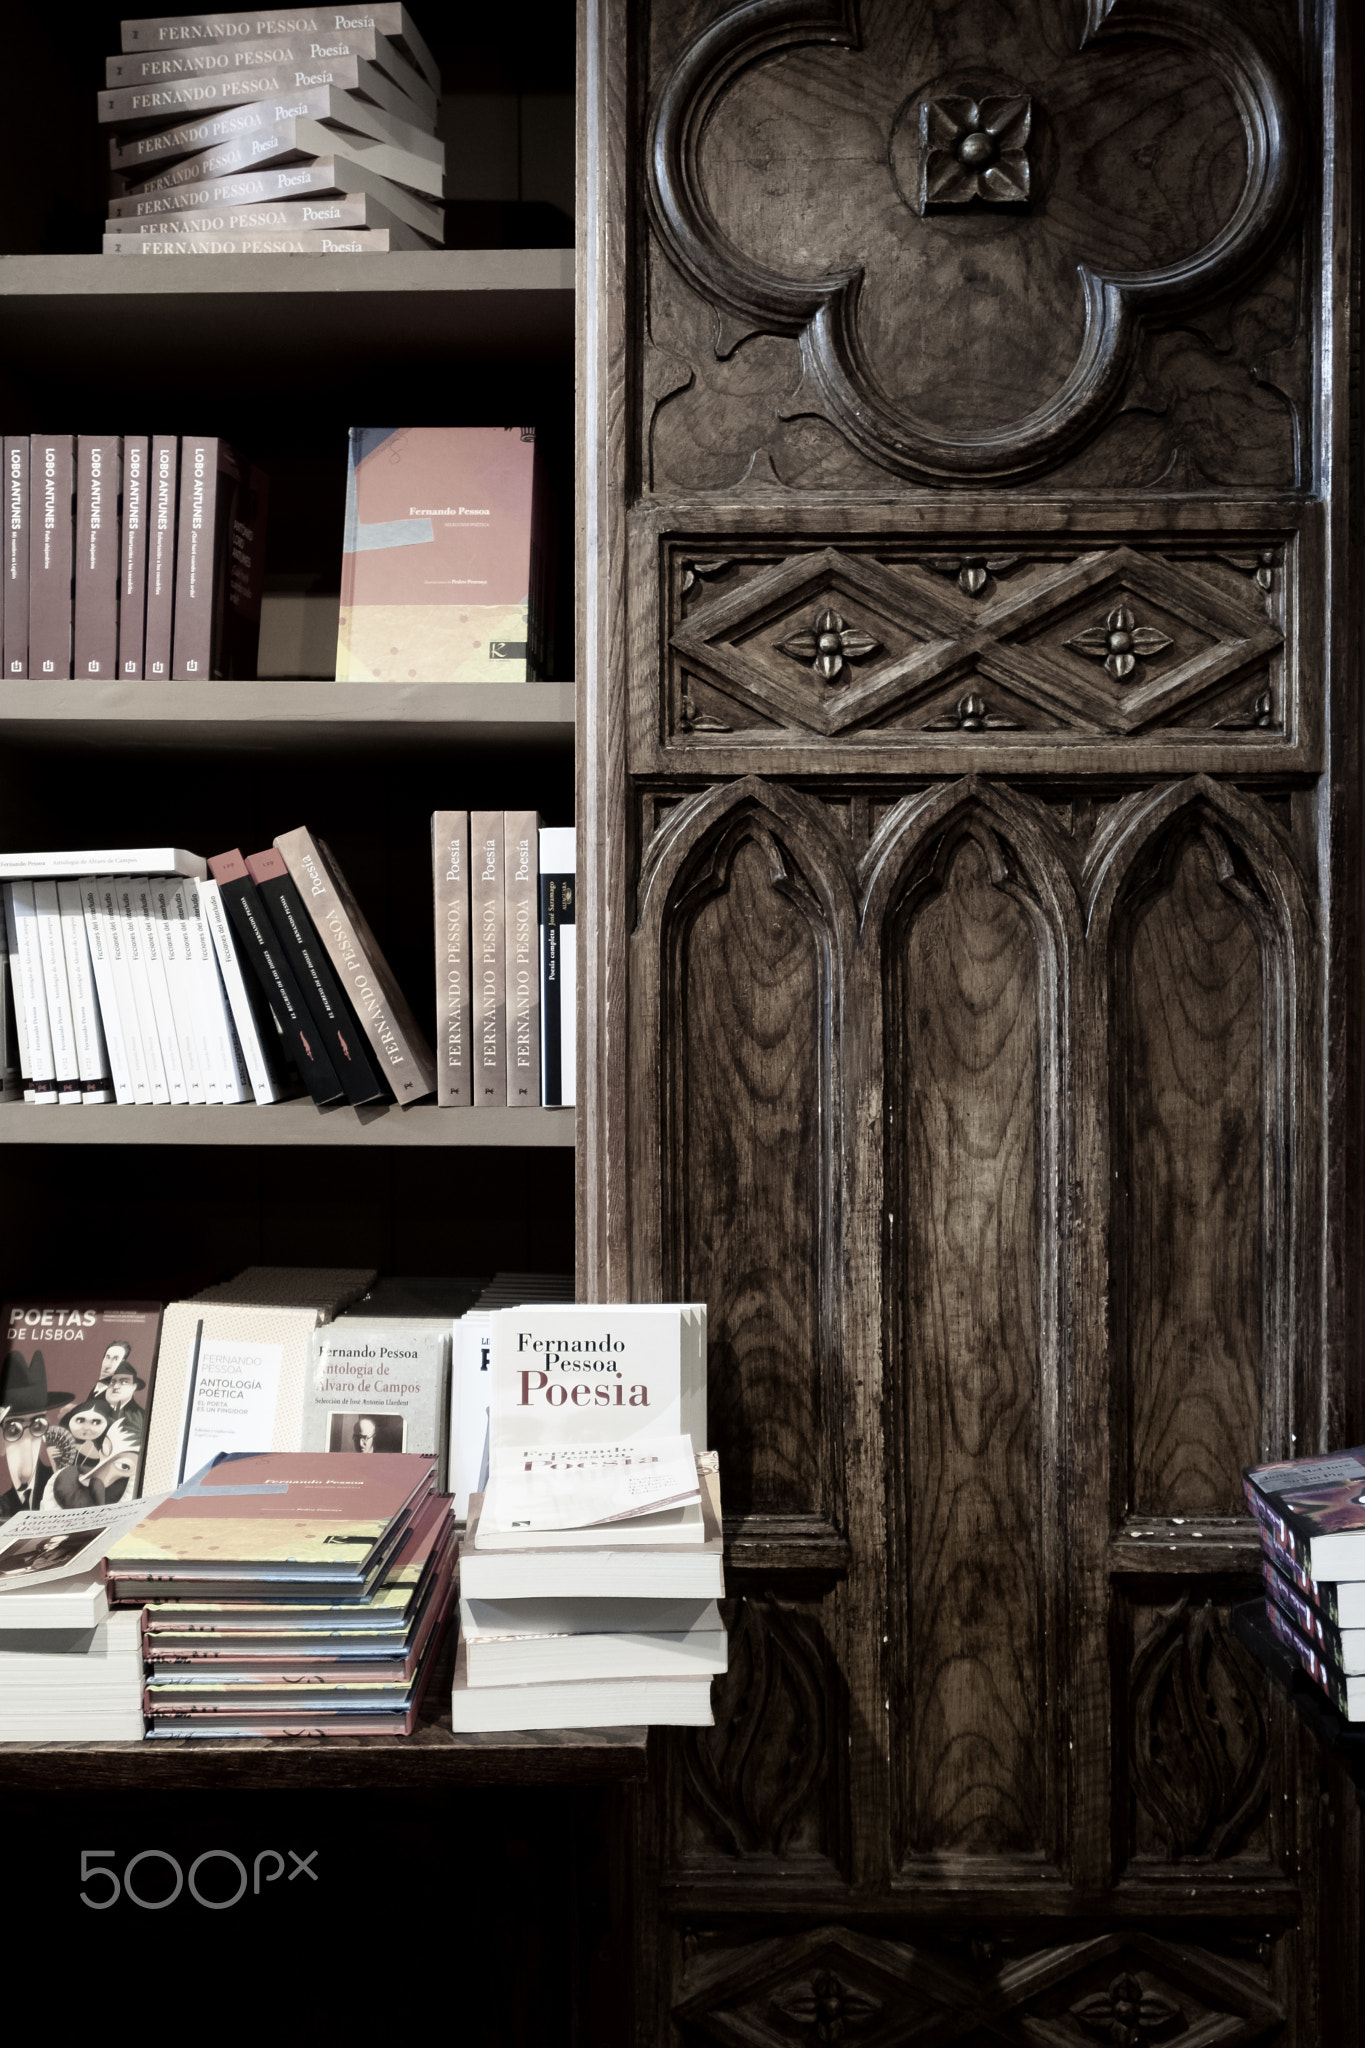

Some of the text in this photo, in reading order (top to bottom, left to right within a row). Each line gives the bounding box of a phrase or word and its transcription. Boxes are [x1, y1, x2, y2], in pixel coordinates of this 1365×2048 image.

[159, 15, 375, 41] FERNANDO PESSOA Poesía
[142, 42, 350, 76] FERNANDO PESSOA Poesía
[132, 71, 333, 108] FERNANDO PESSOA Poesía
[137, 103, 308, 154] FERNANDO PESSOA Poesía
[144, 135, 278, 194] FERNANDO PESSOA Poesía
[136, 173, 311, 216] FERNANDO PESSOA Poesía
[140, 206, 340, 234] FERNANDO PESSOA Poesía
[142, 239, 362, 254] FERNANDO PESSOA Poesía
[11, 450, 21, 530] LOBO ANTUNES
[45, 448, 54, 529] LOBO ANTUNES
[91, 448, 101, 529] LOBO ANTUNES
[129, 449, 140, 529] LOBO ANTUNES
[158, 450, 169, 530] LOBO ANTUNES
[193, 448, 204, 529] LOBO ANTUNES
[410, 507, 490, 516] Fernando Pessoa
[87, 893, 96, 920] interludio
[105, 893, 114, 920] interludio
[122, 893, 131, 920] interludio
[140, 894, 149, 920] interludio
[158, 894, 168, 920] interludio
[175, 894, 184, 920] interludio
[191, 894, 201, 920] interludio
[240, 896, 252, 916] PESSOA
[279, 895, 291, 914] PESSOA
[548, 881, 556, 911] Saramago
[209, 896, 232, 962] Ficciones del interludio
[248, 917, 265, 945] FERNANDO
[287, 914, 303, 943] FERNANDO
[95, 932, 104, 960] Ficciones
[112, 932, 122, 960] Ficciones
[130, 932, 139, 960] Ficciones
[148, 932, 157, 960] Ficciones
[166, 932, 176, 960] Ficciones
[183, 932, 192, 960] Ficciones
[200, 932, 208, 960] Ficciones
[302, 854, 403, 1065] FERNANDO PESSOA Poesía
[447, 839, 461, 1067] FERNANDO PESSOA Poesía
[482, 839, 496, 1067] FERNANDO PESSOA Poesía
[516, 839, 530, 1068] FERNANDO PESSOA Poesía
[9, 1308, 97, 1326] POETAS
[7, 1328, 85, 1341] DE LISBOA
[516, 1333, 626, 1352] Fernando
[202, 1354, 262, 1366] FERNANDO
[380, 1347, 418, 1358] Pessoa
[544, 1353, 618, 1372] Pessoa
[202, 1364, 242, 1374] PESSOA
[322, 1362, 390, 1378] ntología de
[199, 1388, 244, 1399] POÉTICA
[200, 1378, 262, 1390] ANTOLOGÍA
[358, 1380, 370, 1392] de
[374, 1380, 420, 1396] Campos
[516, 1370, 651, 1407] Poesia
